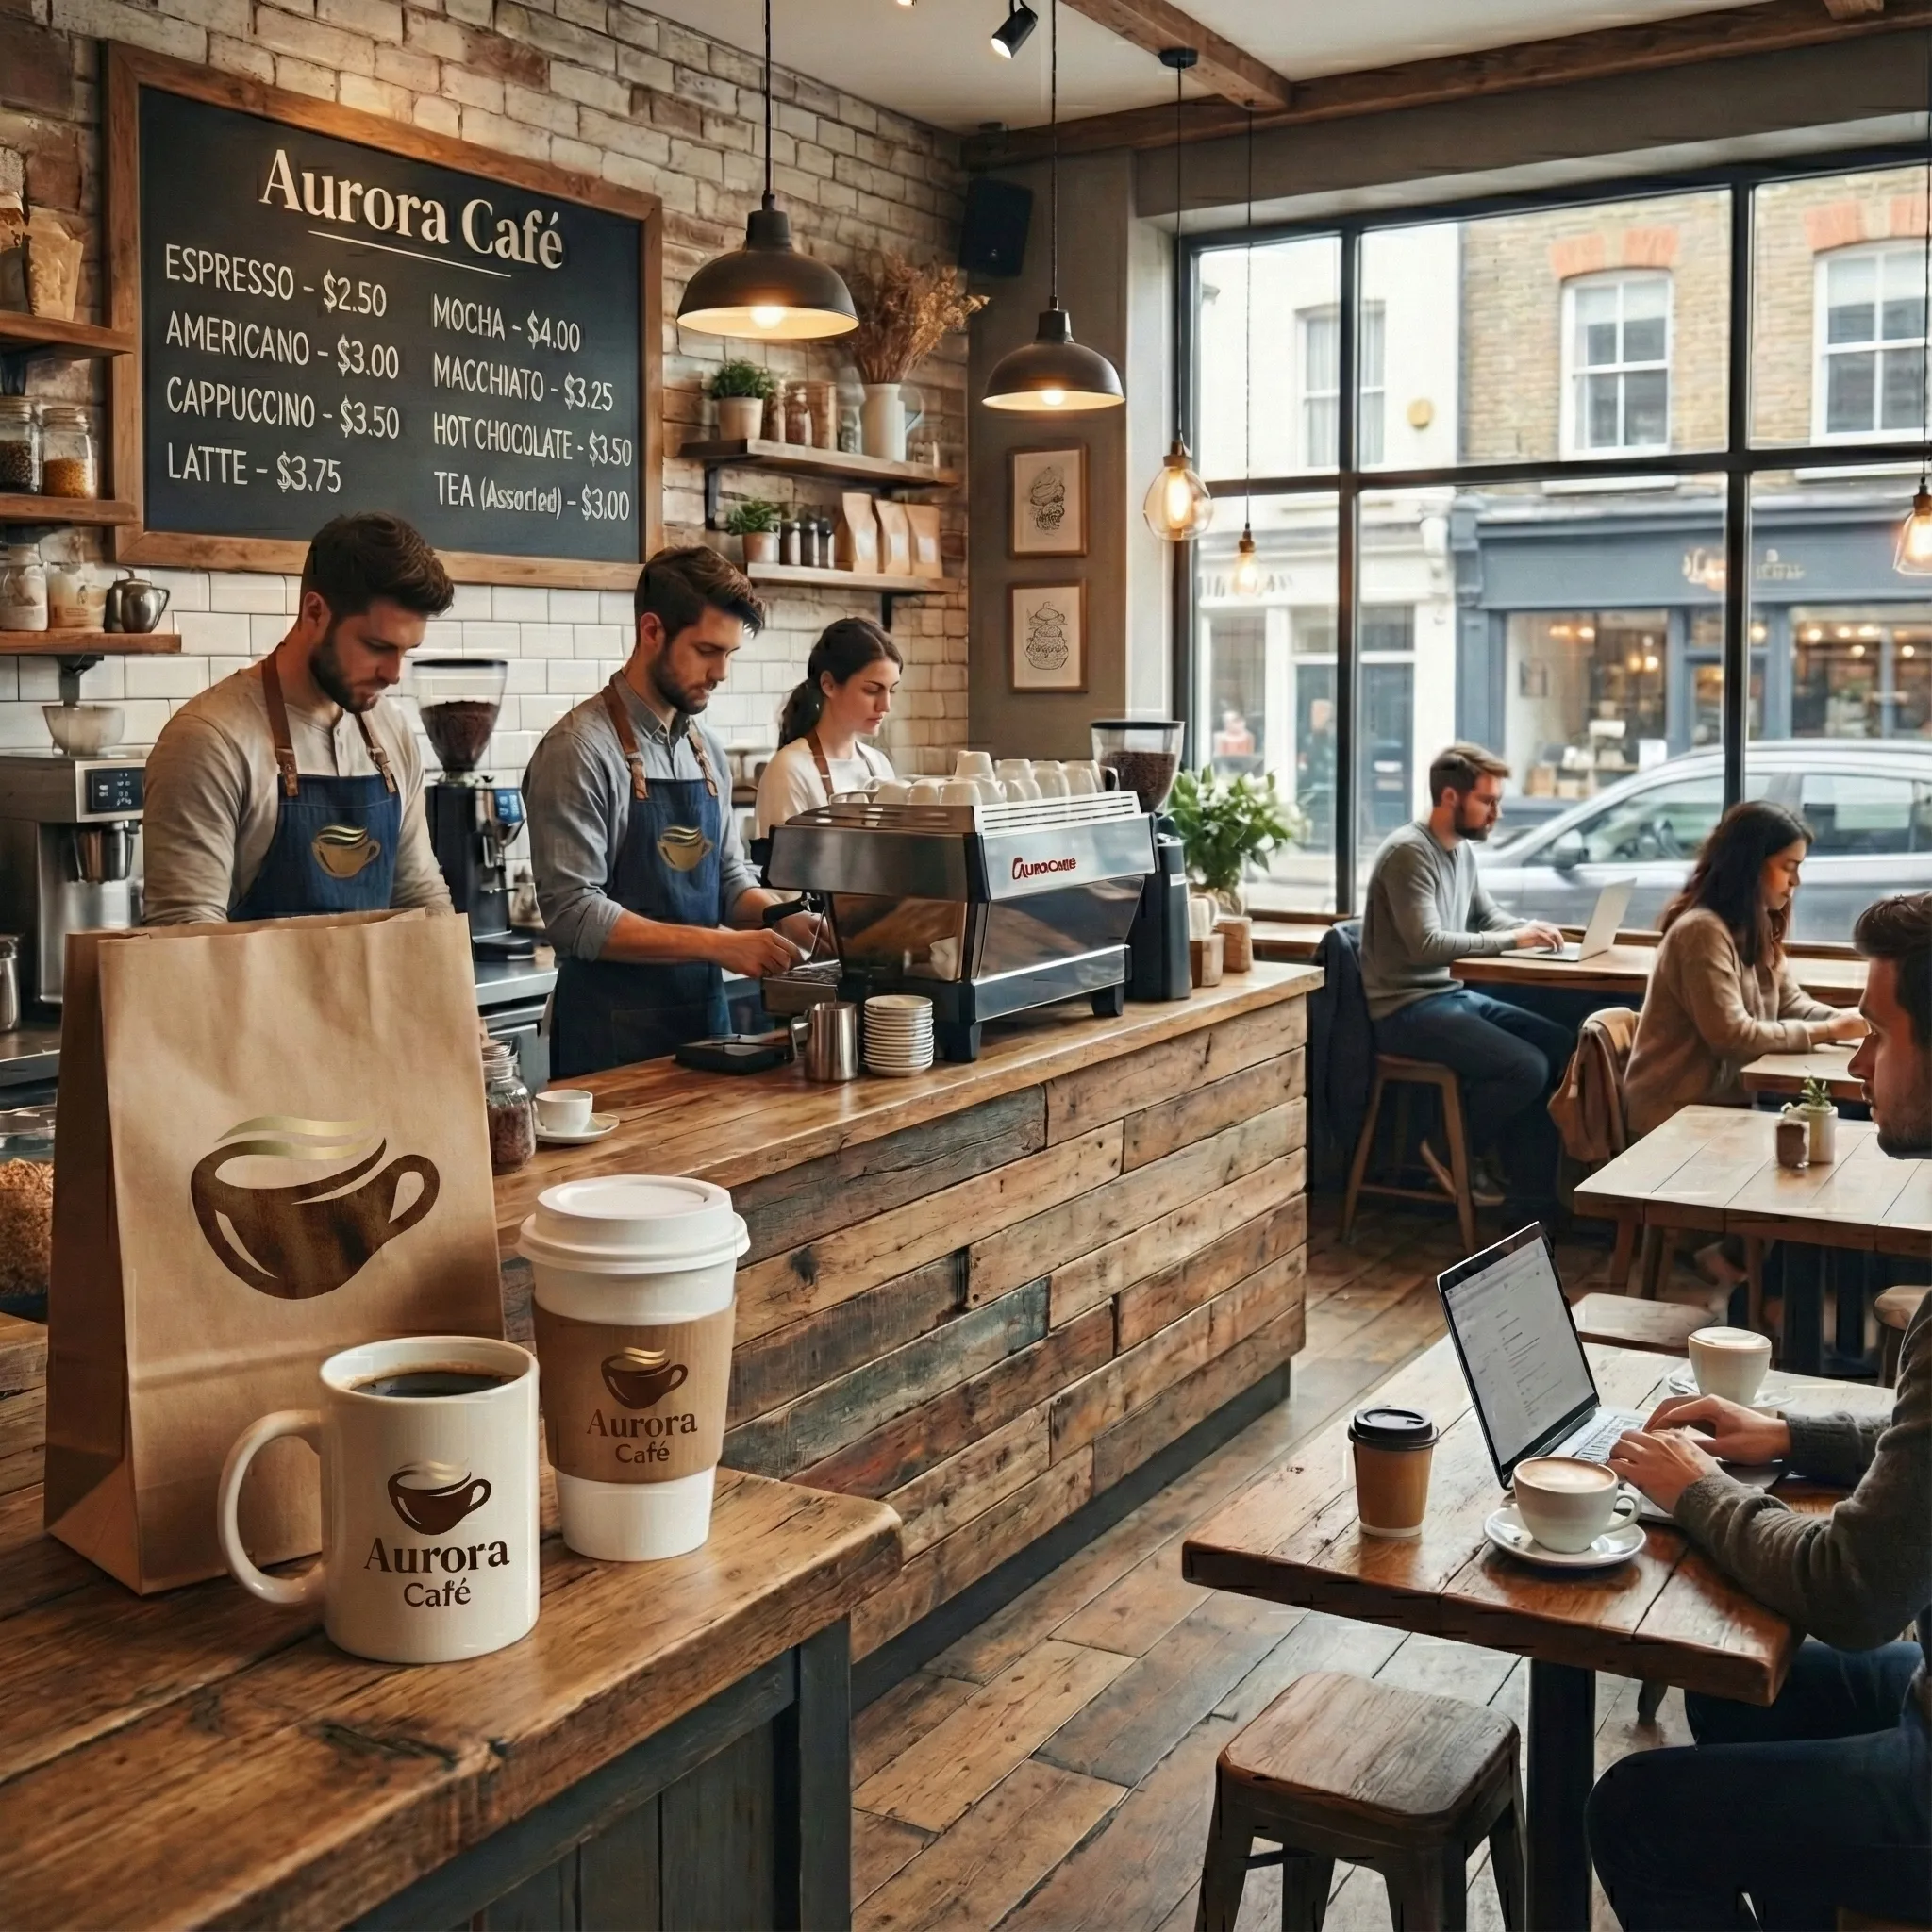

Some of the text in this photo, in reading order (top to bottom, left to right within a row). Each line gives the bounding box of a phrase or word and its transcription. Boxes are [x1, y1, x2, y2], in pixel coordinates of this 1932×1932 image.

[258, 149, 563, 270] Aurora Café
[165, 243, 294, 301] ESPRESSO
[323, 269, 387, 317] $2.50
[165, 310, 309, 366] AMERICANO
[337, 334, 399, 379] $3.00
[433, 293, 506, 341] MOCHA
[527, 309, 581, 353] $4.00
[166, 376, 315, 428] CAPPUCCINO
[340, 394, 400, 439] $3.50
[434, 351, 544, 402] MACCHIATO
[564, 371, 613, 412] $3.25
[168, 442, 248, 485] LATTE
[276, 451, 341, 493] $3.75
[434, 411, 472, 449] HOT
[475, 418, 573, 460] CHOCOLATE
[589, 429, 632, 468] $3.50
[433, 471, 475, 508] TEA
[581, 483, 630, 521] $3.00
[586, 1408, 698, 1439] Aurora
[615, 1440, 670, 1464] Café
[363, 1537, 510, 1574] Aurora
[403, 1576, 472, 1607] Café
